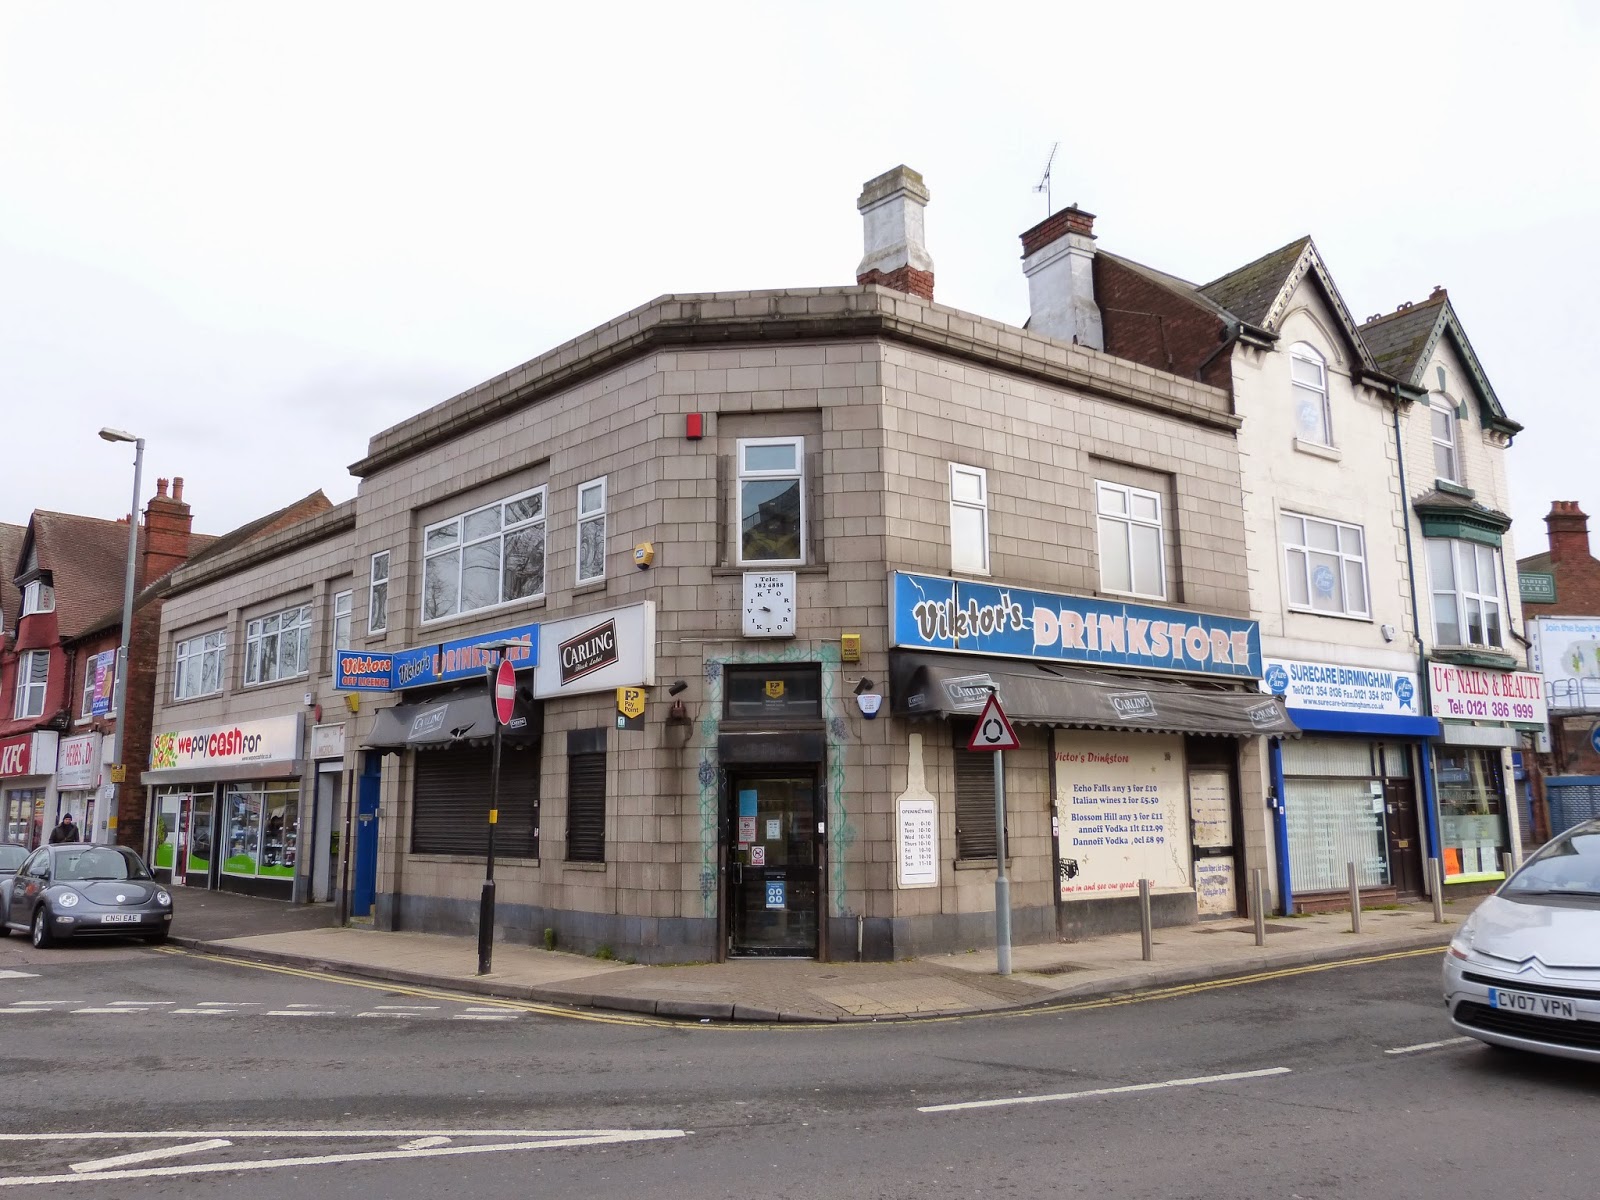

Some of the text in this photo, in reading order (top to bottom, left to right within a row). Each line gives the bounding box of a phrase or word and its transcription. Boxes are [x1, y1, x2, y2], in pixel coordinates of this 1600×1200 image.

[913, 592, 1250, 666] Viktor's DRINKSTORE
[1545, 624, 1560, 632] Join
[1561, 624, 1575, 632] the
[563, 631, 613, 668] CARLING
[341, 657, 391, 675] Viktors
[342, 676, 390, 687] OFF LICENCE
[1290, 664, 1393, 690] SURECARE (BIRMINGHAM)
[1456, 669, 1489, 696] NAILS
[1492, 674, 1499, 697] &
[1501, 674, 1541, 700] BEAUTY
[1316, 687, 1328, 697] 354
[1329, 688, 1342, 698] 8136
[1368, 692, 1379, 701] 354
[1380, 692, 1393, 702] 8137
[1113, 696, 1150, 711] CARLING
[1447, 698, 1534, 719] Tel: 0121 386 1999
[0, 743, 26, 774] KFC
[1087, 752, 1129, 765] Drinkstore
[1073, 784, 1092, 792] Echo
[1093, 784, 1111, 792] Falls
[1072, 796, 1098, 804] Italian
[1128, 796, 1139, 804] for
[1071, 813, 1103, 821] Blossom
[1103, 813, 1118, 821] Hill
[1072, 837, 1104, 846] Dannoff
[1105, 837, 1129, 845] Vodka
[1083, 882, 1096, 890] and
[105, 914, 122, 922] CN51
[1499, 993, 1572, 1016] CV07 VPN
